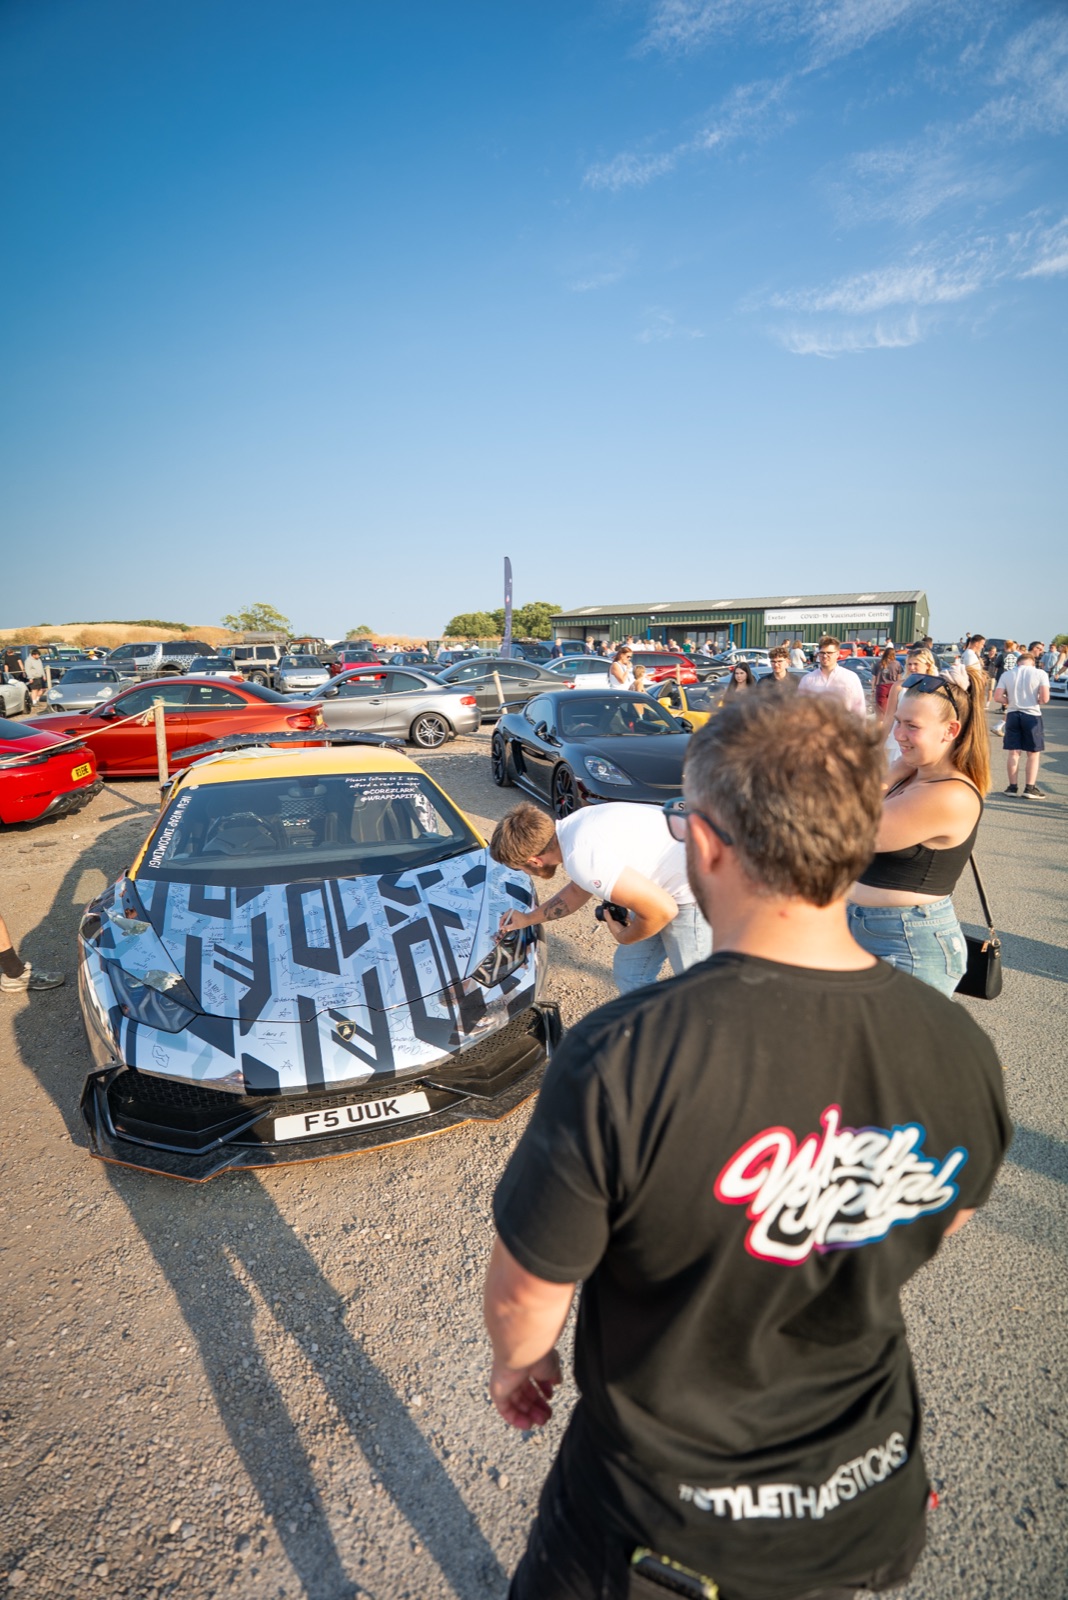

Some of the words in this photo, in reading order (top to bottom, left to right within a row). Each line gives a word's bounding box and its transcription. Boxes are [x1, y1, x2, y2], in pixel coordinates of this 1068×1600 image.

[176, 795, 192, 809] NEW
[167, 810, 185, 828] WRAP
[148, 828, 175, 868] INCOMING!
[304, 1110, 340, 1132] F5
[346, 1099, 400, 1123] UUK
